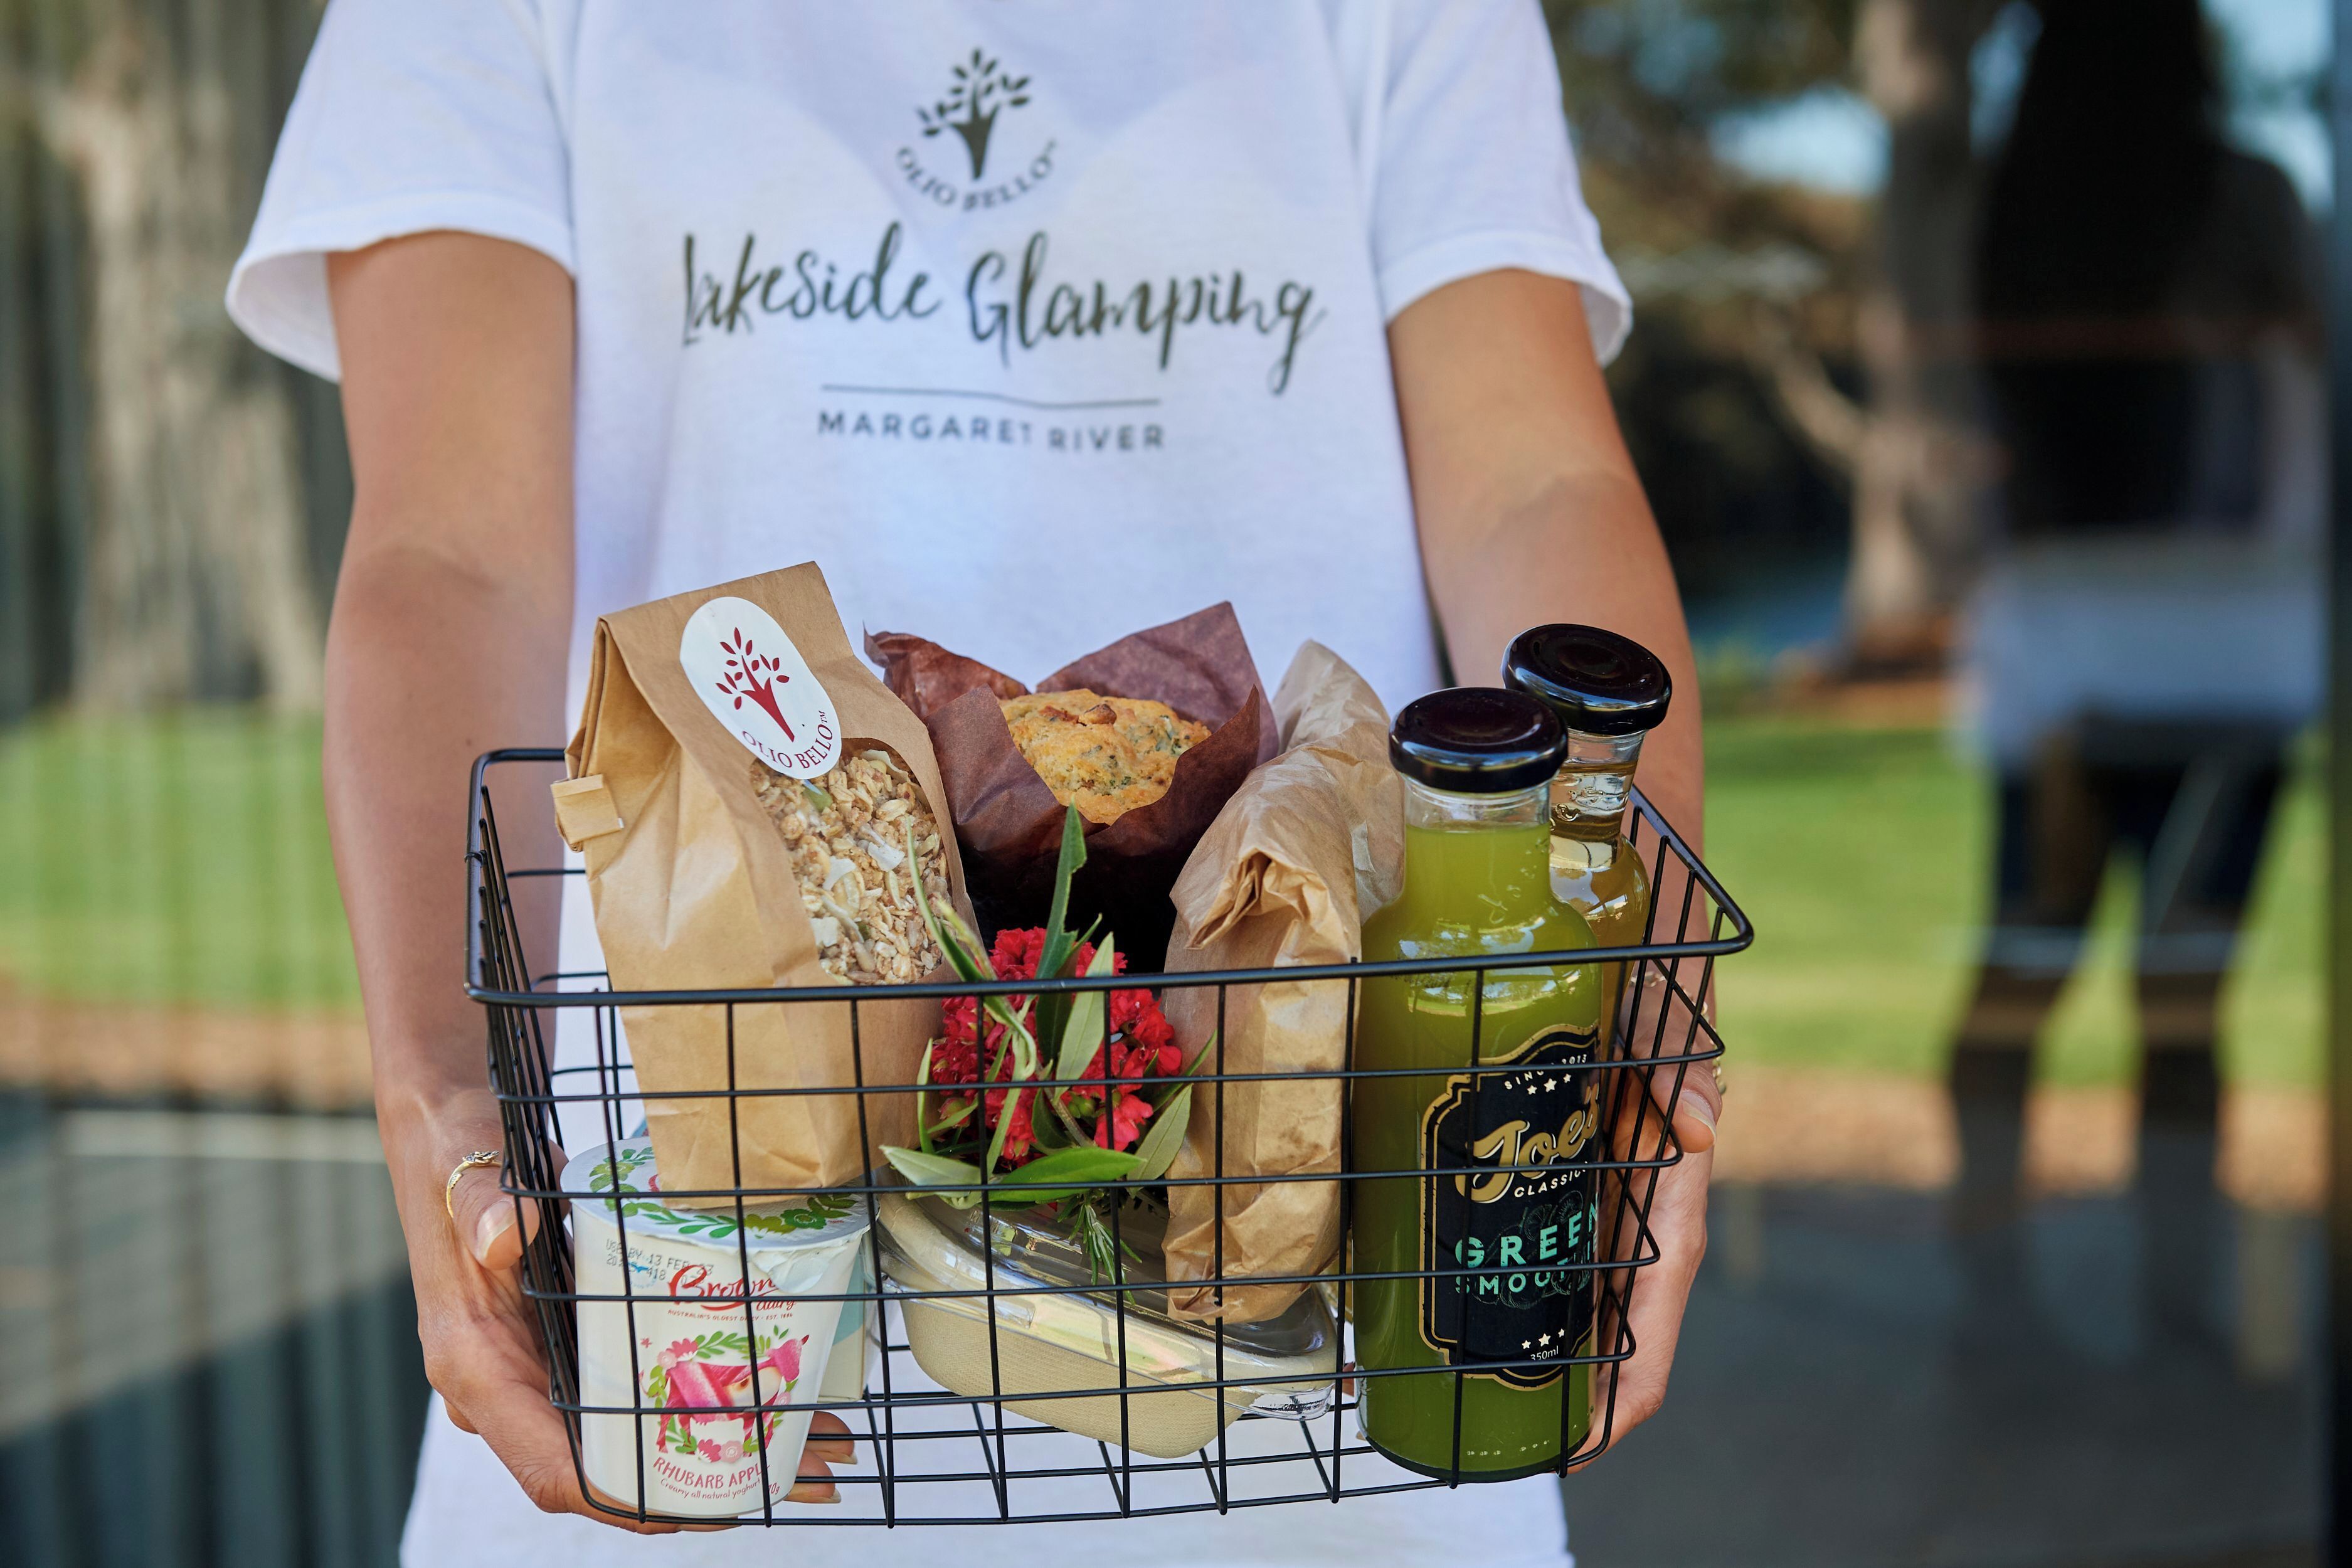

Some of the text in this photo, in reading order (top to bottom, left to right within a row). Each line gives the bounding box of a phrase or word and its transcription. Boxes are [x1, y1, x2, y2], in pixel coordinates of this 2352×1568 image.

[896, 146, 956, 206] OLIO
[681, 220, 1328, 396] Lakeside Glamping
[818, 411, 1164, 453] MARGARET RIVER
[742, 731, 793, 768] OLIO
[1454, 1202, 1597, 1269] GREEN
[1530, 1345, 1559, 1361] 350ml
[653, 1456, 771, 1489] RHUBARB APPL
[660, 1478, 690, 1499] Creamy
[702, 1491, 730, 1500] natural
[732, 1478, 761, 1500] yoghurt
